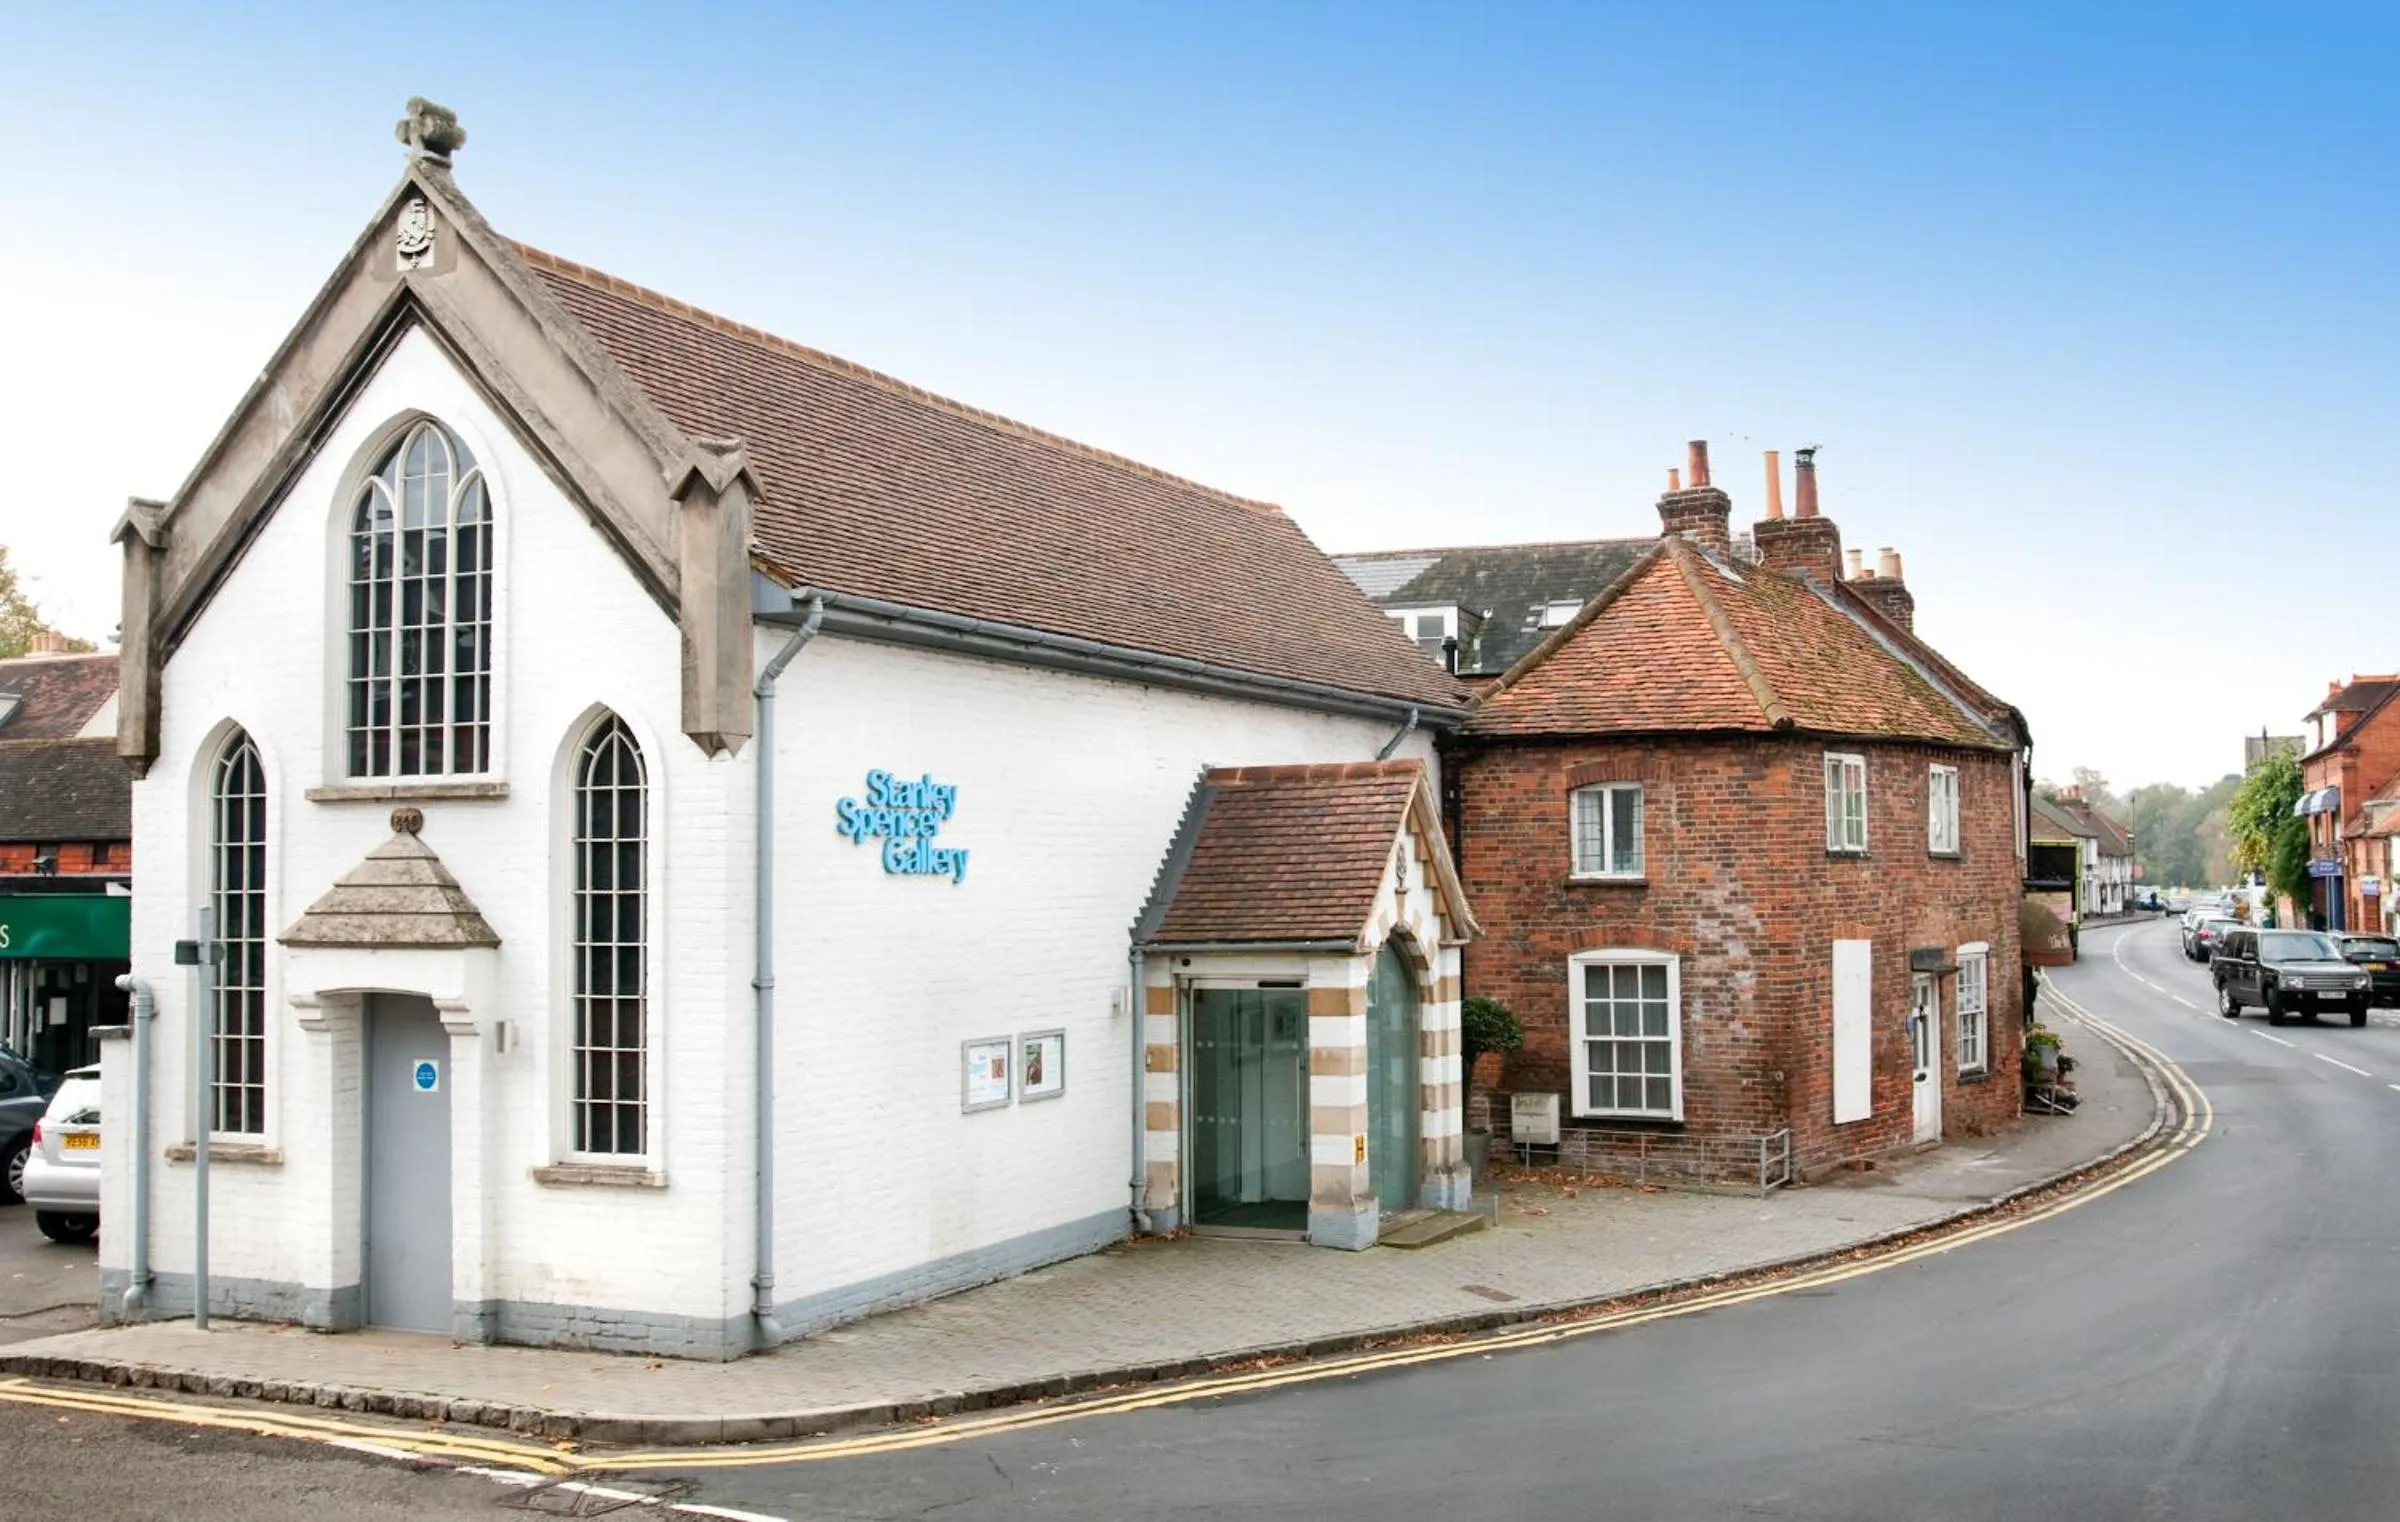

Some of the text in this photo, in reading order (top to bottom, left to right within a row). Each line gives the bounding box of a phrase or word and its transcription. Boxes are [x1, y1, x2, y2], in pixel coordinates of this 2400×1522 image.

[866, 769, 957, 820] Stanley
[836, 797, 939, 845] Spencer
[882, 836, 969, 885] Gallery
